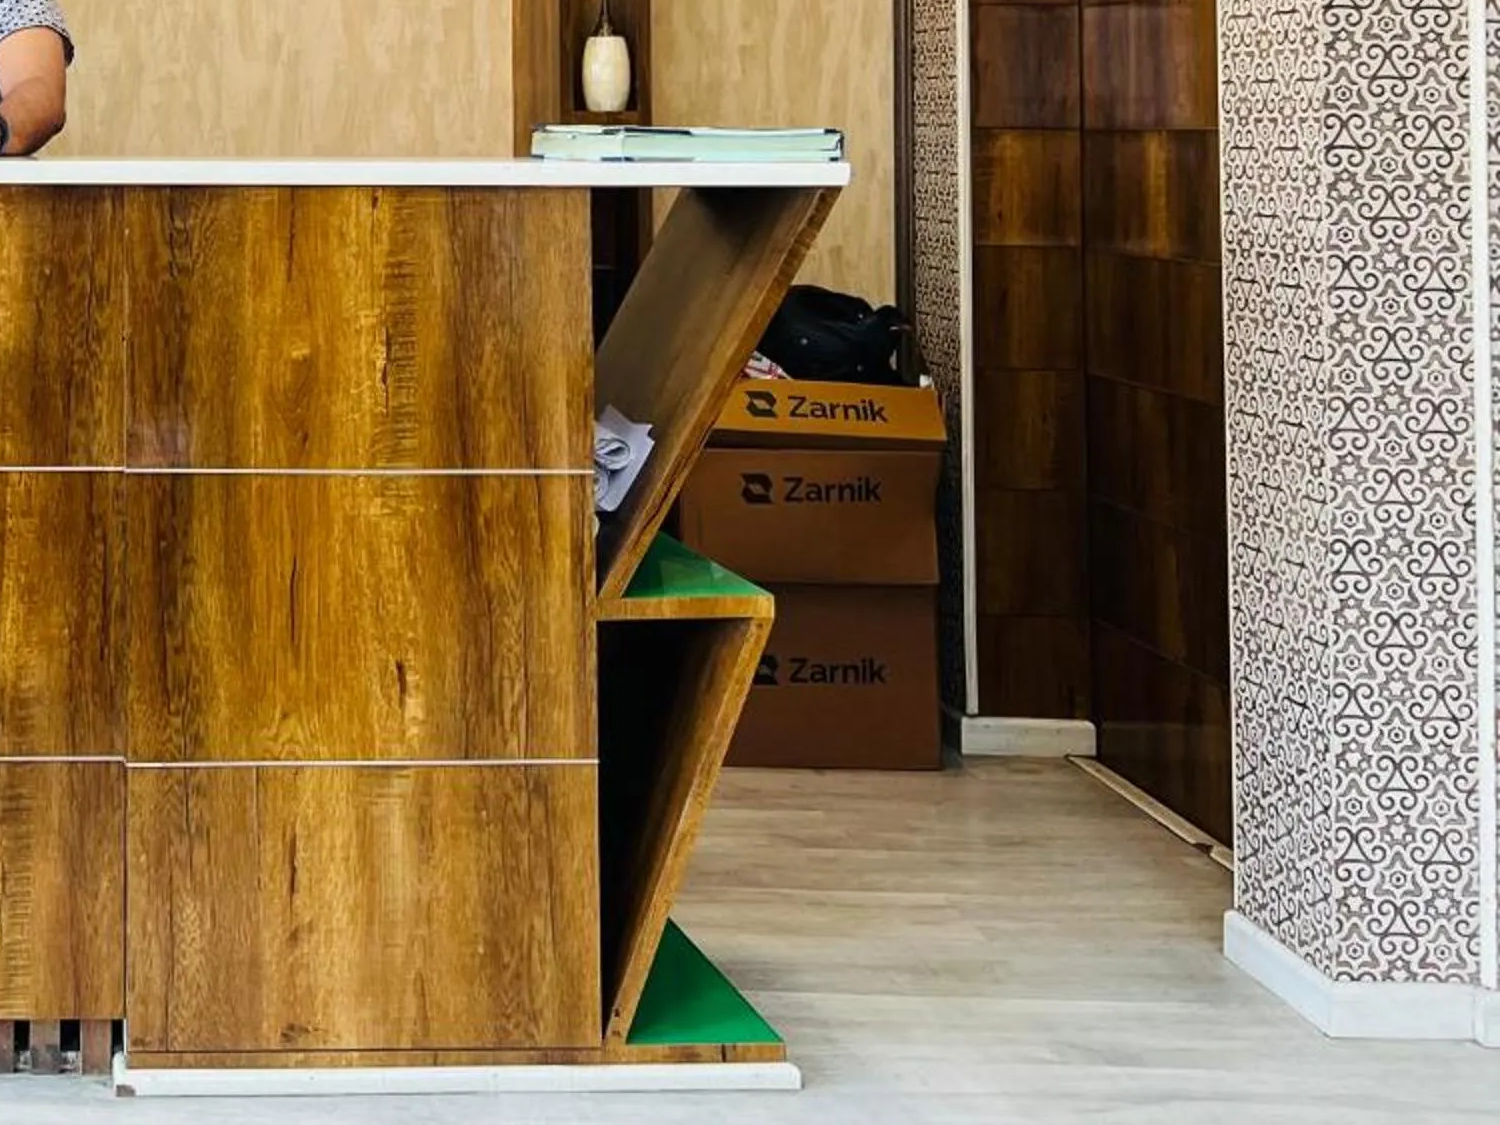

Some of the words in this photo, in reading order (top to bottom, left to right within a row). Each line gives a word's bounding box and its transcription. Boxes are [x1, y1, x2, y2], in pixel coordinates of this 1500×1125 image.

[787, 395, 889, 423] Zarnik
[783, 477, 883, 504] Zarnik
[788, 657, 888, 685] Zarnik
